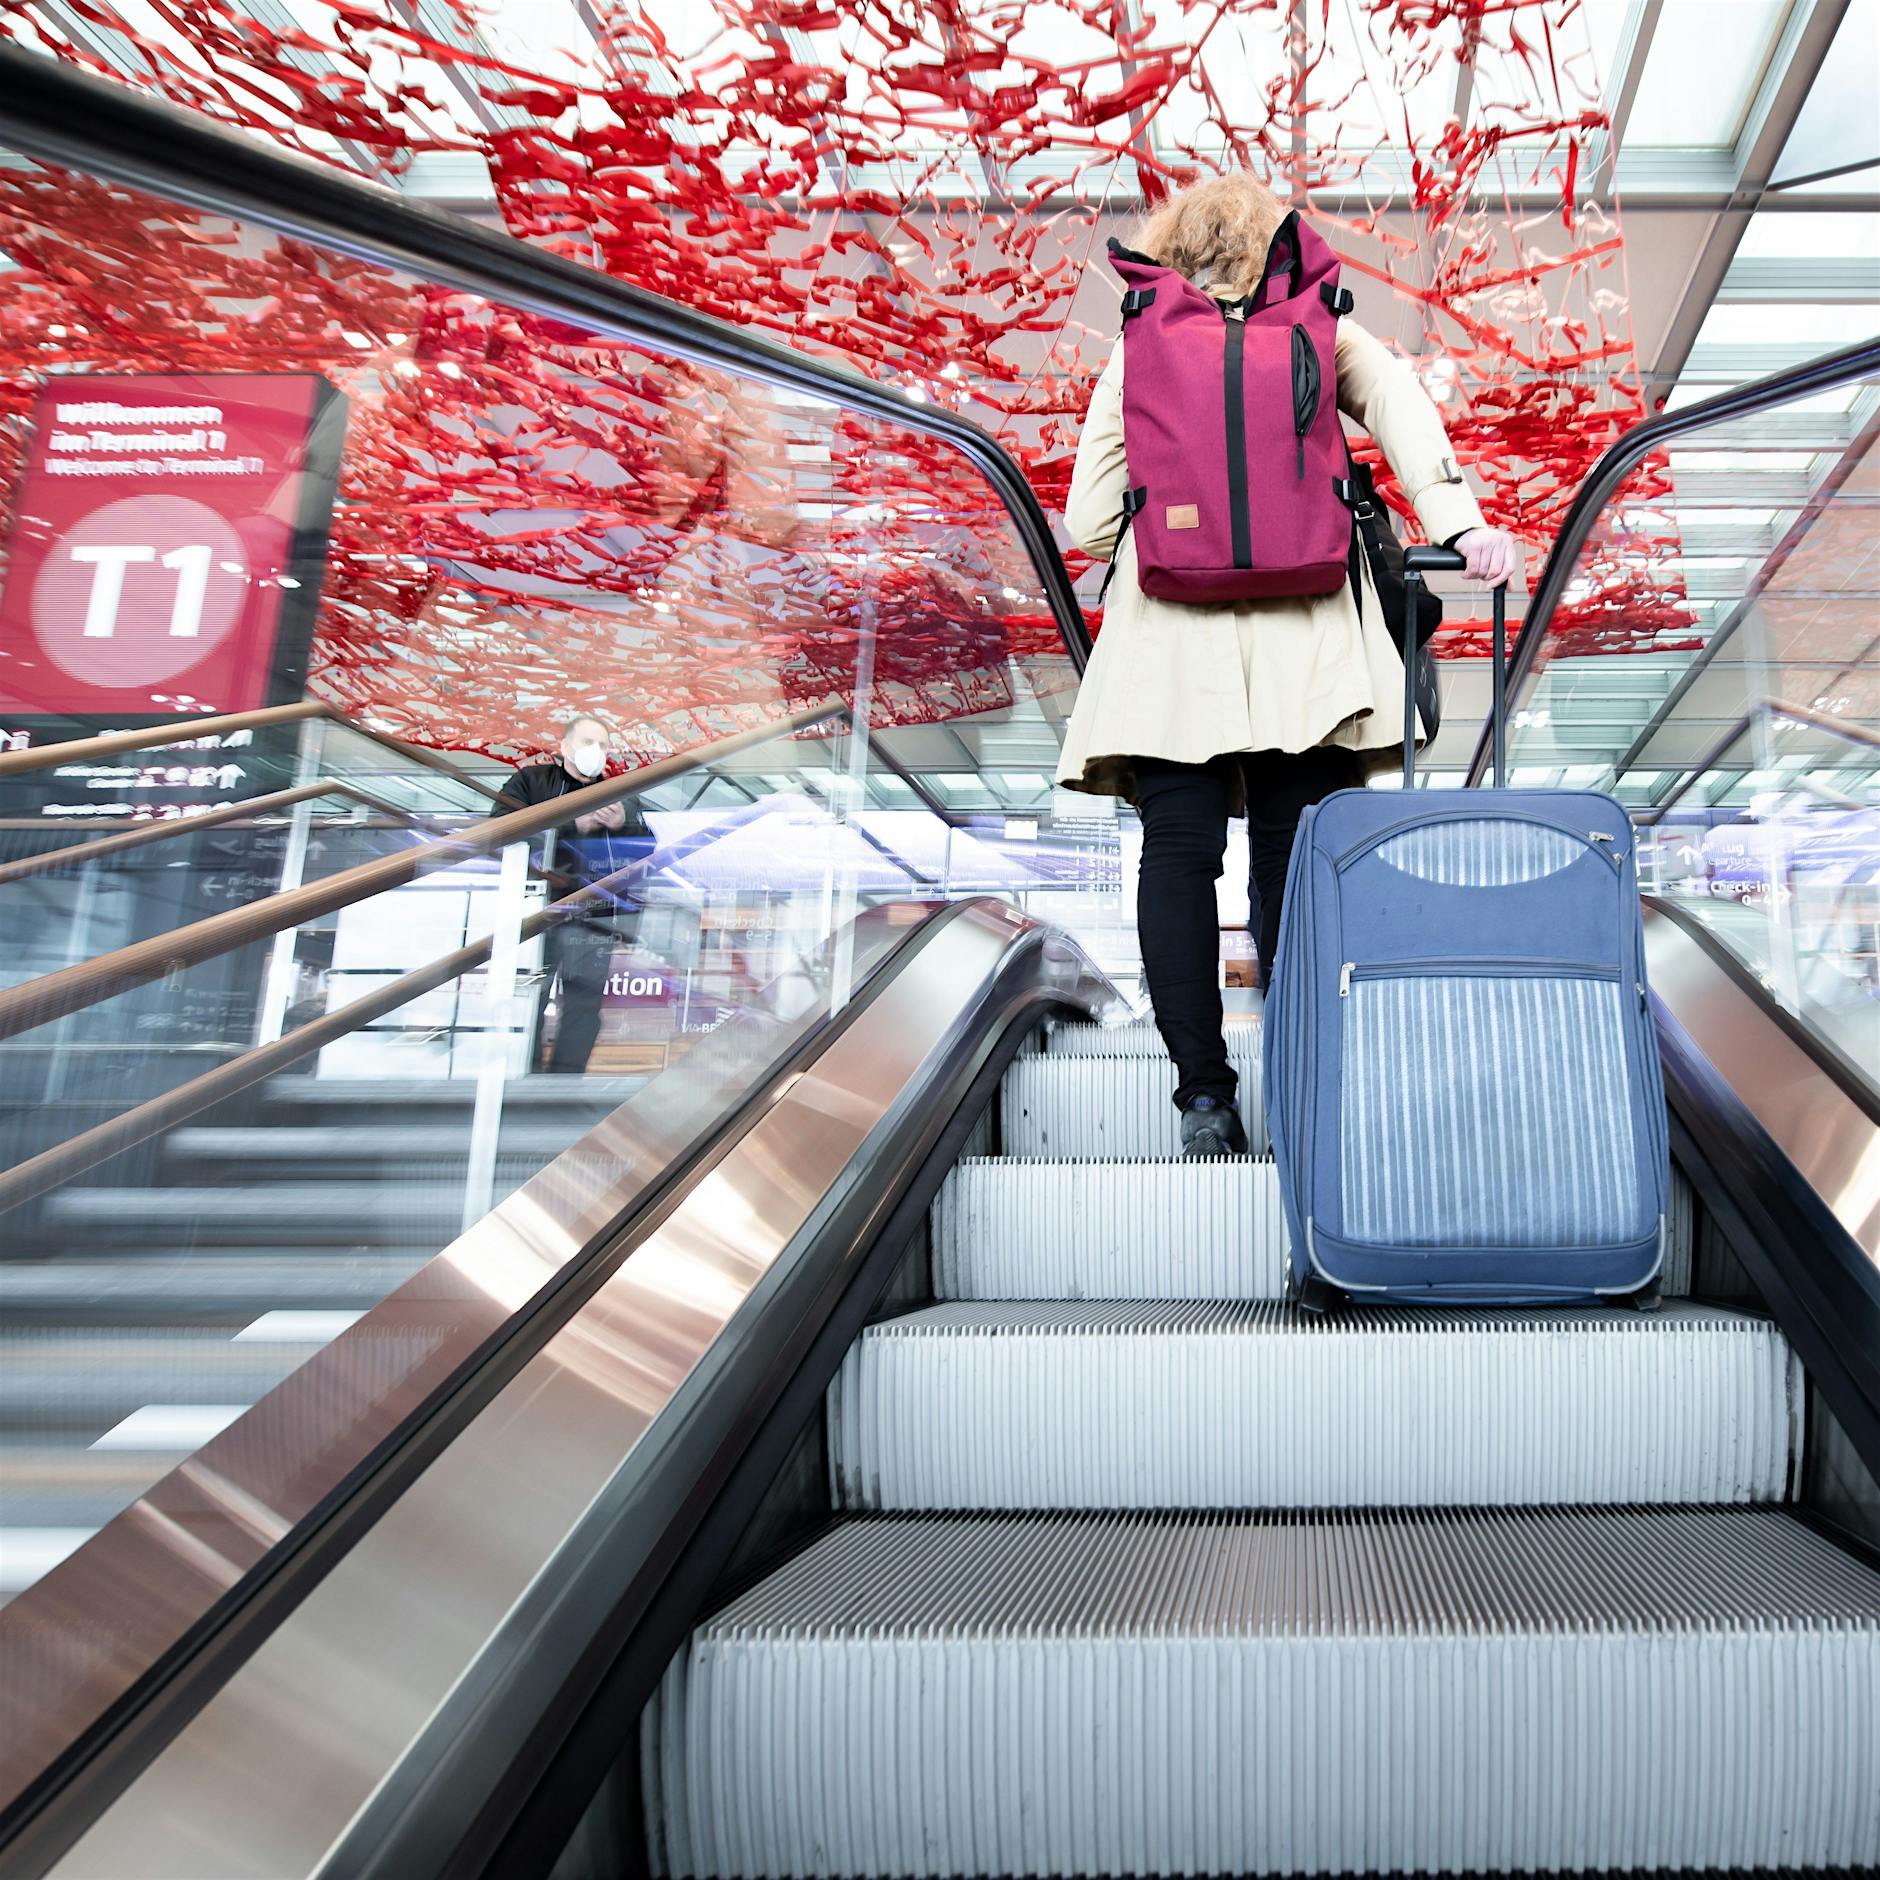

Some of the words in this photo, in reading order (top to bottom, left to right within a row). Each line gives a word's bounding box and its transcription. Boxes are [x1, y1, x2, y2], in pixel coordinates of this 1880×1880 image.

[56, 402, 223, 425] Willkommen
[48, 430, 90, 452] im
[88, 429, 207, 452] Terminal
[208, 430, 226, 451] 1
[45, 457, 139, 476] Welcome
[160, 456, 248, 475] Terminal
[71, 545, 212, 638] T1
[1711, 880, 1770, 893] Check-in
